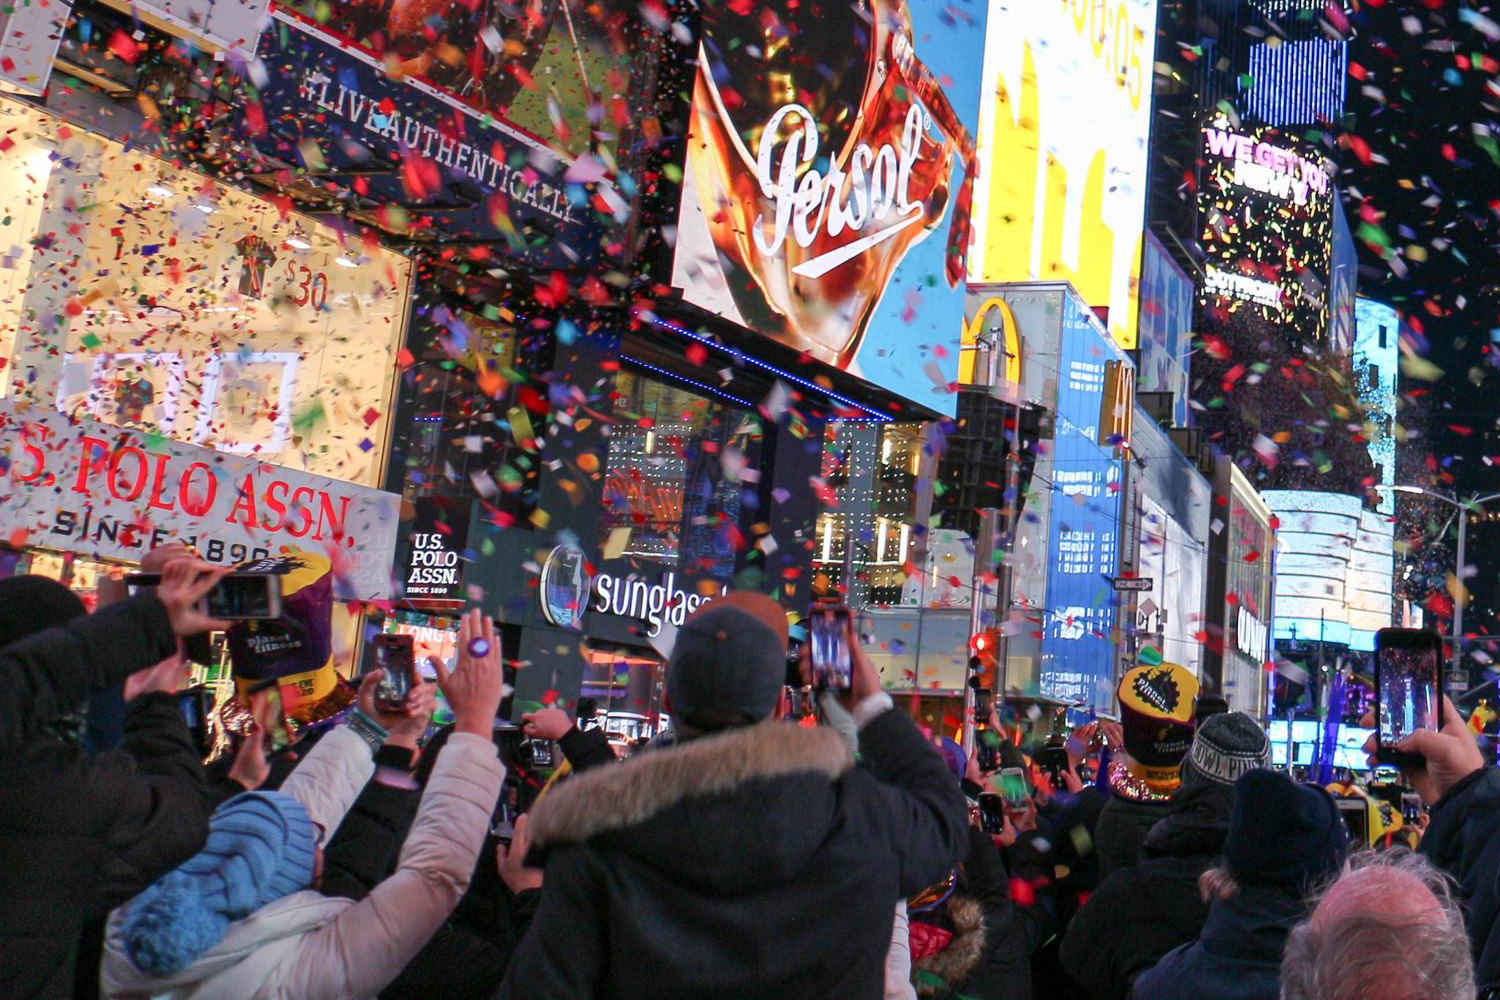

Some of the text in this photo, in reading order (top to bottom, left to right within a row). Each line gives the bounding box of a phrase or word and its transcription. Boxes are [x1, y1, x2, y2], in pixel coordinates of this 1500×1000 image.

[300, 68, 579, 223] #LIVEAUTHENTICALLY
[1206, 128, 1329, 195] WE GET YOU
[752, 104, 925, 257] Persol
[1234, 160, 1291, 199] NEW
[286, 260, 328, 311] $30
[70, 436, 218, 518] POLO
[225, 473, 356, 548] ASSN.
[410, 551, 458, 568] POLO
[414, 533, 445, 550] U.S.
[406, 586, 448, 594] SINCE 1890
[408, 567, 459, 585] ASSN.
[597, 572, 712, 638] sunglas
[246, 633, 291, 648] planet
[254, 640, 302, 654] fitness
